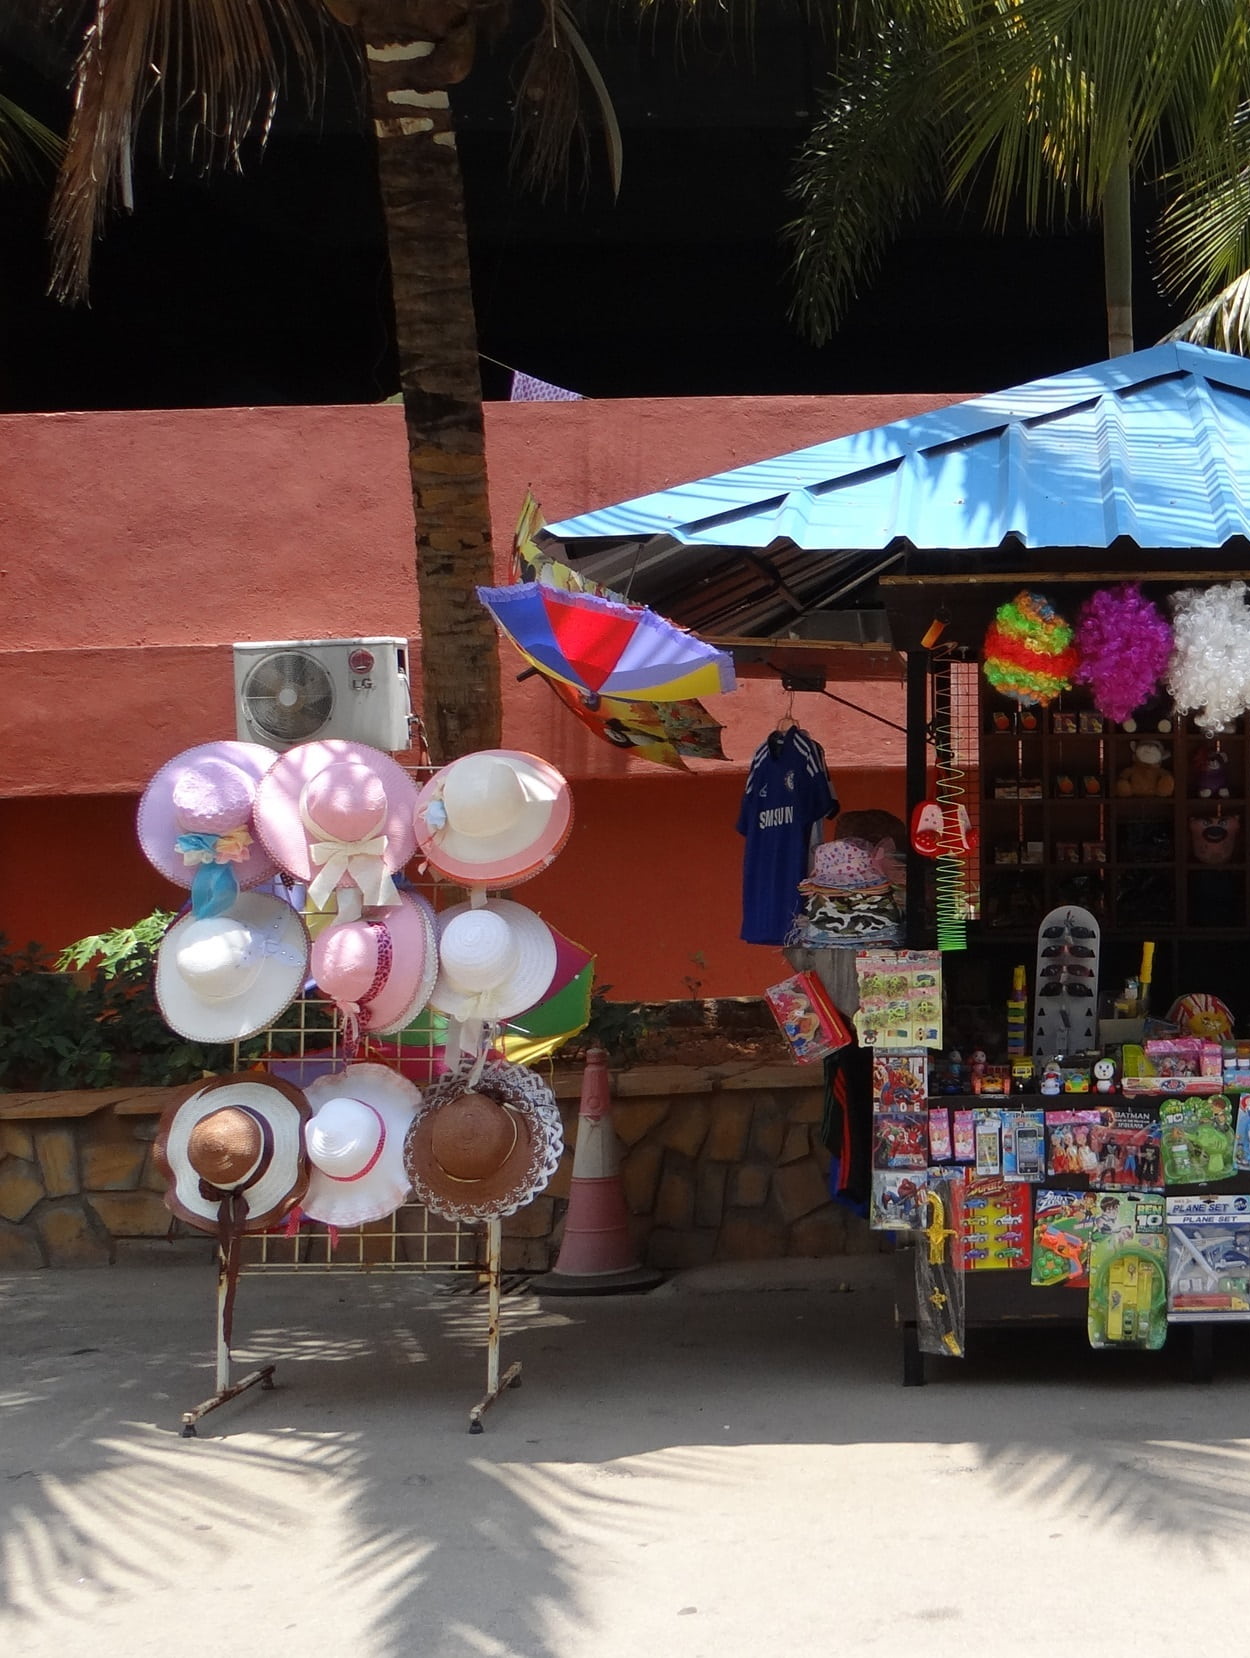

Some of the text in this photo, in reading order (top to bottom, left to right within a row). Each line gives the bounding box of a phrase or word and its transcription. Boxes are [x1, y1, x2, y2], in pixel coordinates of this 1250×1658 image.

[352, 678, 372, 689] LG
[1115, 1111, 1150, 1120] BATMAN
[1166, 1113, 1184, 1124] 10
[1137, 1205, 1163, 1215] BEN
[1172, 1203, 1205, 1214] PLANE
[1208, 1202, 1229, 1213] SET
[1136, 1215, 1163, 1226] 10
[1183, 1215, 1238, 1223] PLANE SET
